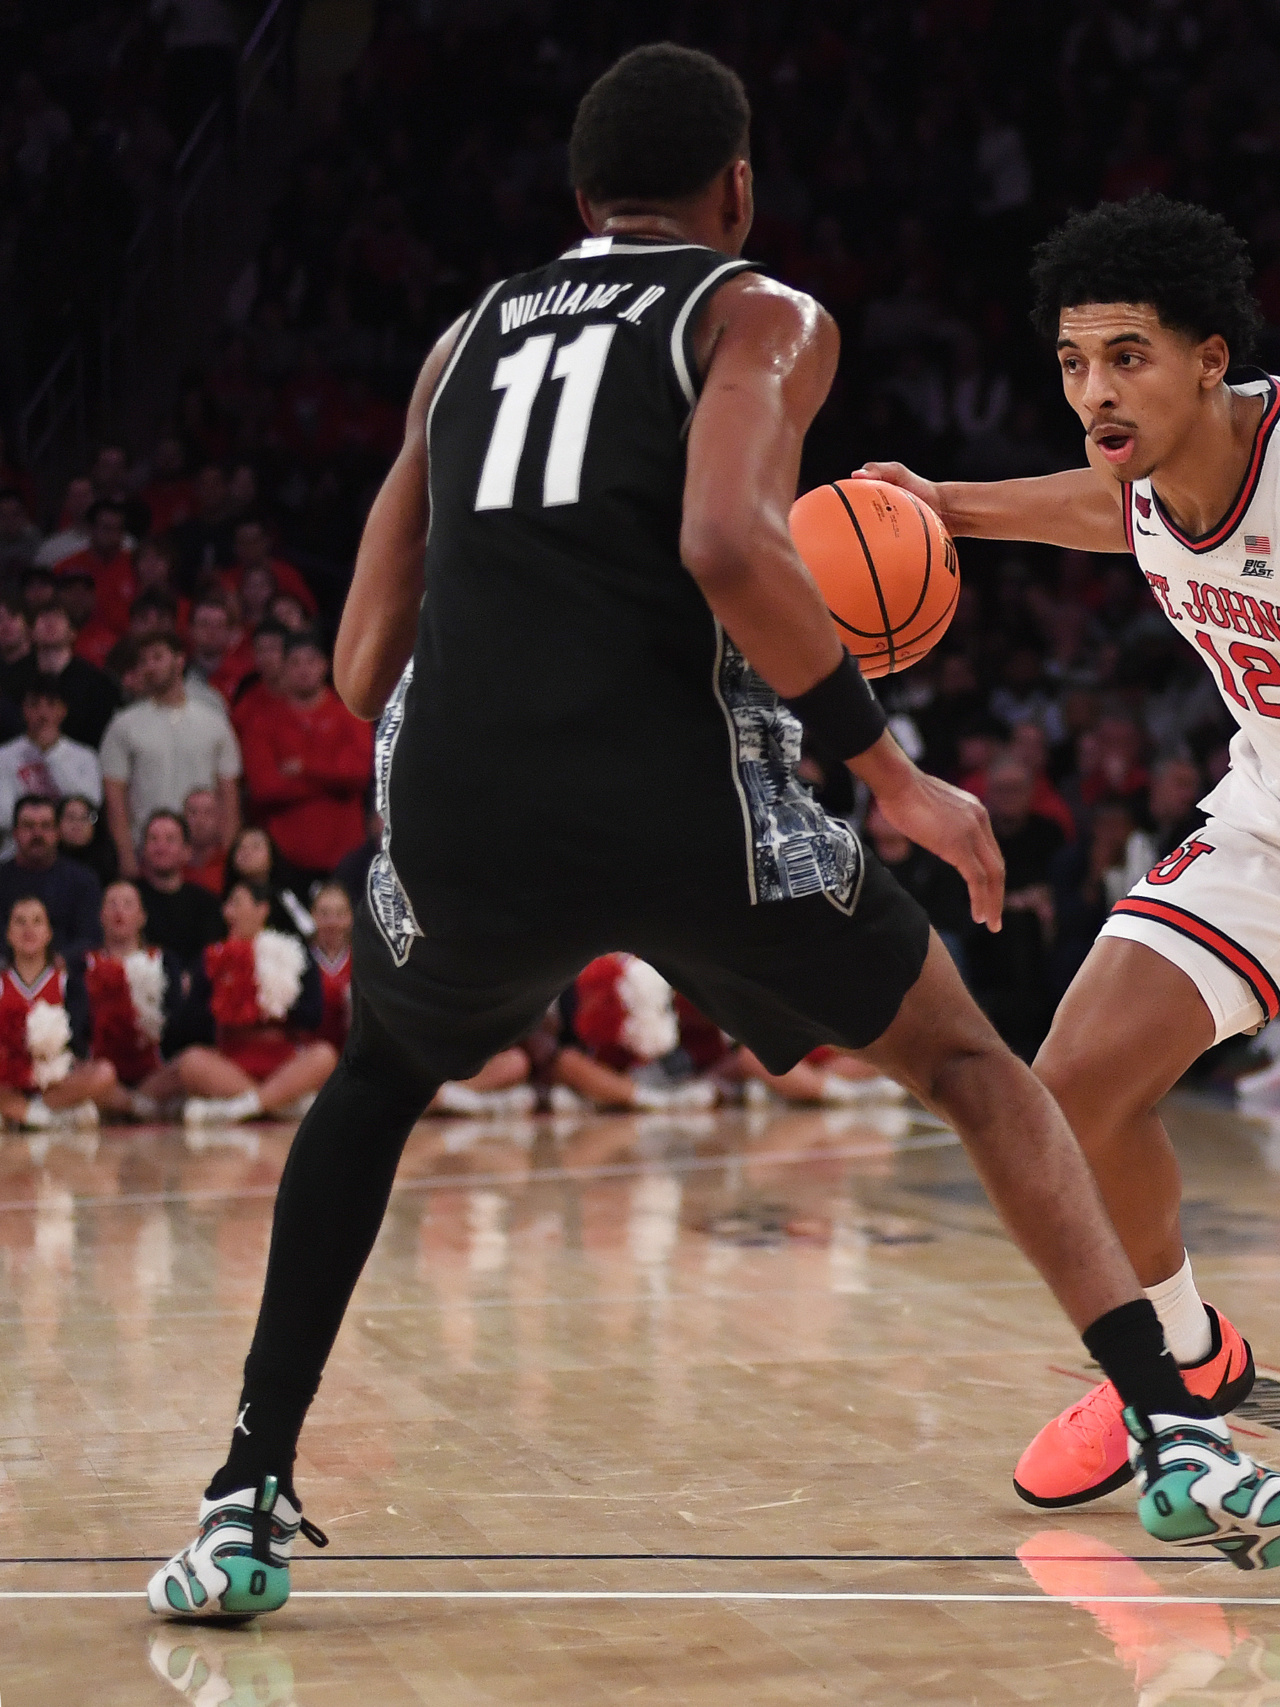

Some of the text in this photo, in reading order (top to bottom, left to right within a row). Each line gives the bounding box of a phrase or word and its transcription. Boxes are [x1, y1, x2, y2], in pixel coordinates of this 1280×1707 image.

[501, 280, 633, 335] WILLIAMS
[474, 323, 618, 512] 11
[1242, 567, 1274, 577] EAST
[1245, 559, 1267, 568] BIG
